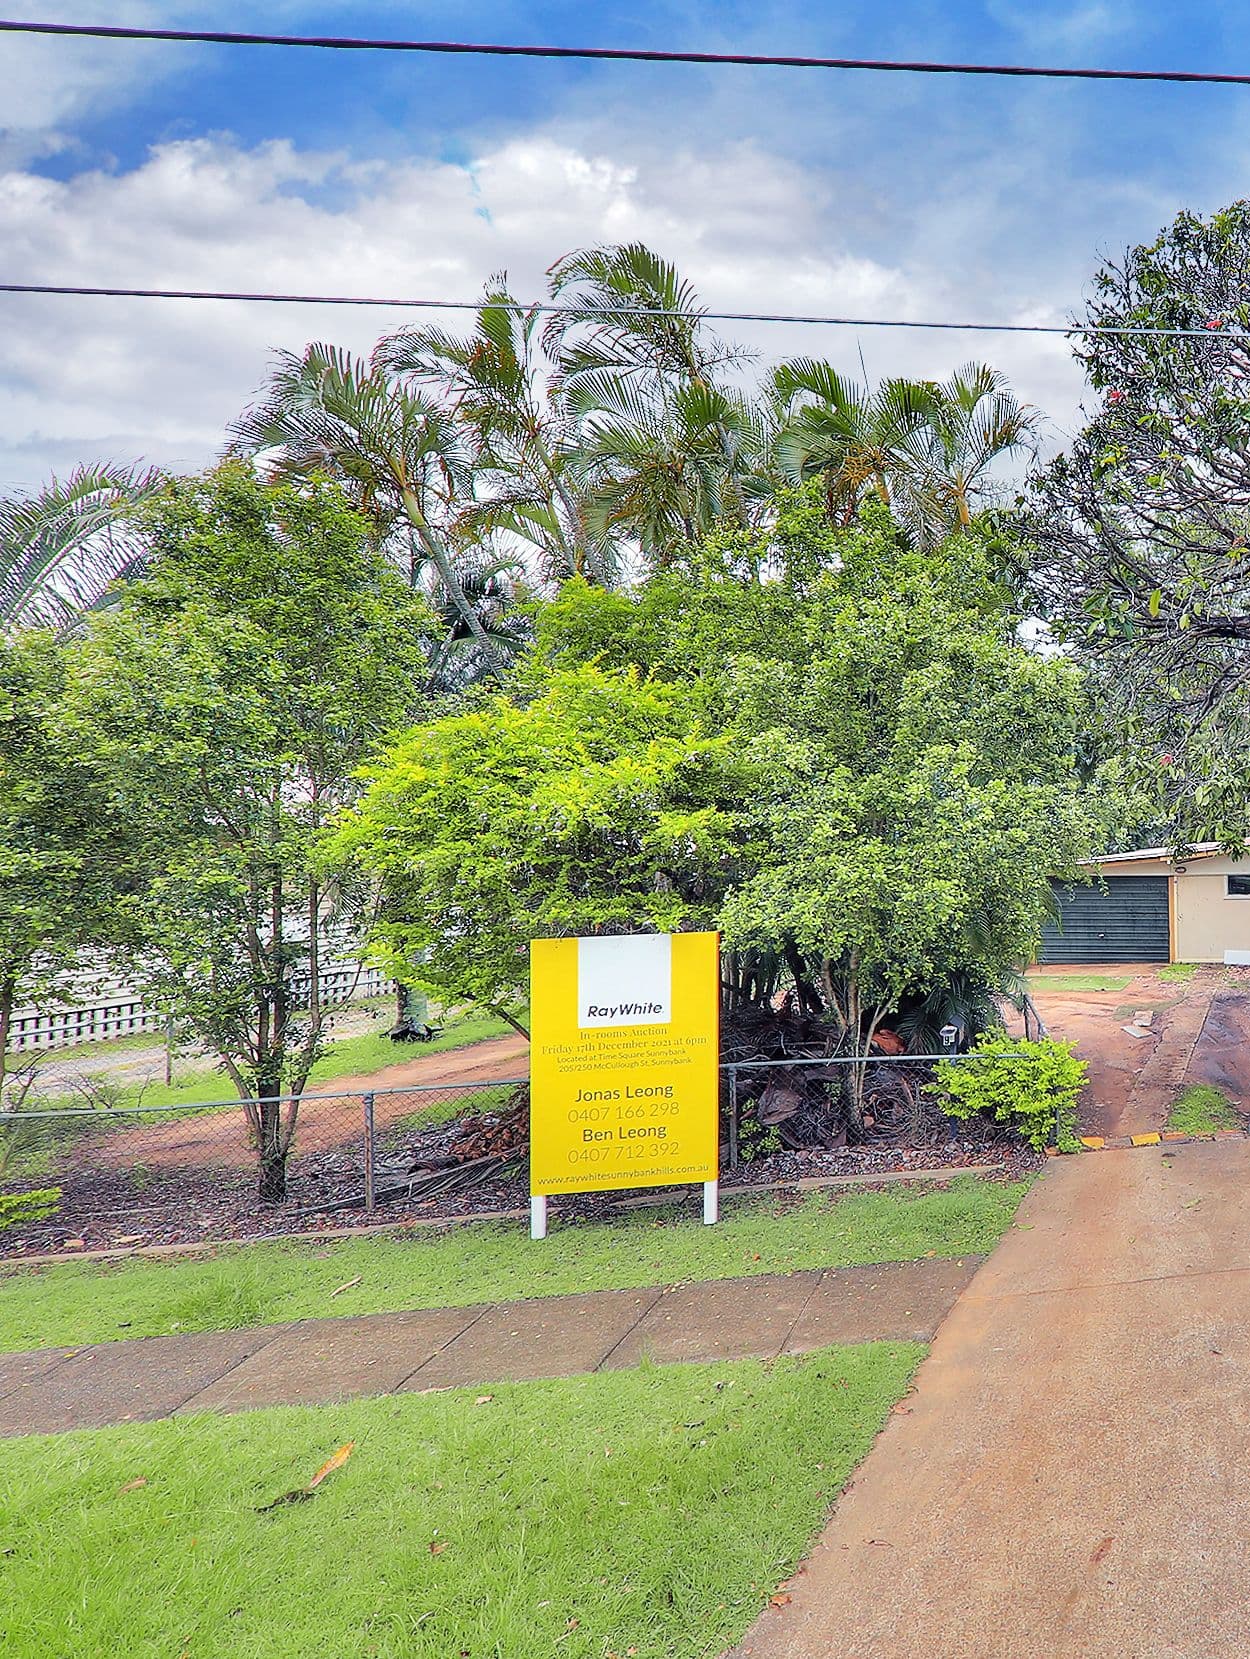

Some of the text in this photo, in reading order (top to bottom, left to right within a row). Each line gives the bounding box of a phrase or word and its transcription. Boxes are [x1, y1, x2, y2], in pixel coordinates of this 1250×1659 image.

[580, 1028, 667, 1040] In-rooms Auction
[541, 1036, 707, 1055] Friday 17th December 2021 at 6pm
[557, 1053, 587, 1063] Located
[599, 1052, 617, 1061] Time
[618, 1051, 645, 1060] Square
[646, 1048, 686, 1058] Sunnybank
[651, 1057, 692, 1066] Sunnybank
[575, 1085, 674, 1102] Jonas Leong
[567, 1102, 680, 1123] 0407 166 298
[583, 1125, 667, 1142] Ben Leong
[567, 1142, 680, 1164] 0407 712 392
[537, 1165, 709, 1185] www.raywhitesunnybankhills.com.au
